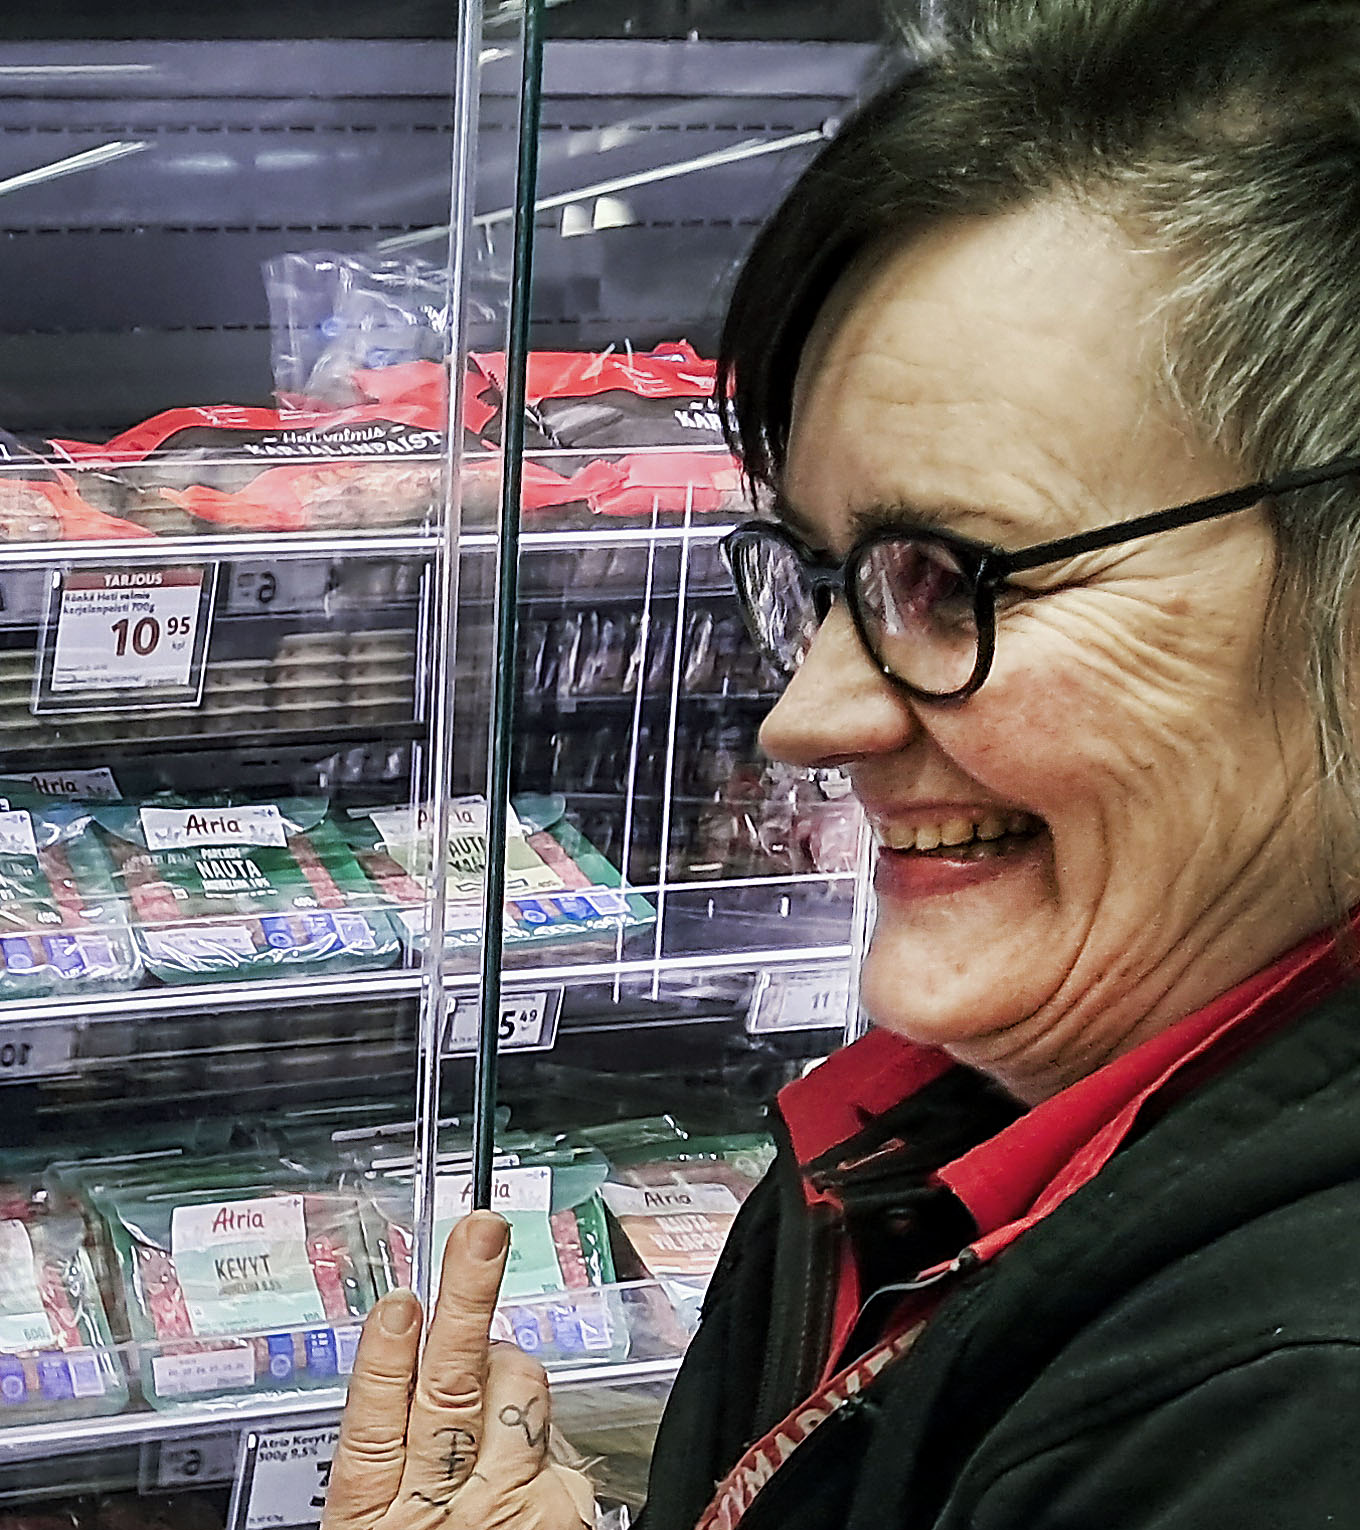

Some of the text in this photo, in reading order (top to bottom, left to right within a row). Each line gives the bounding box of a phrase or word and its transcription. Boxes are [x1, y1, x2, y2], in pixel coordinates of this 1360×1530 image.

[243, 430, 443, 456] KARJALANPAIST
[104, 572, 164, 587] TARJOUS
[111, 616, 191, 657] 10 95
[185, 813, 241, 836] Atria
[195, 859, 263, 880] NAUTA
[499, 1009, 538, 1041] 5 49
[643, 1191, 693, 1208] Atria
[211, 1206, 265, 1233] Atria
[214, 1253, 273, 1282] KEVYT
